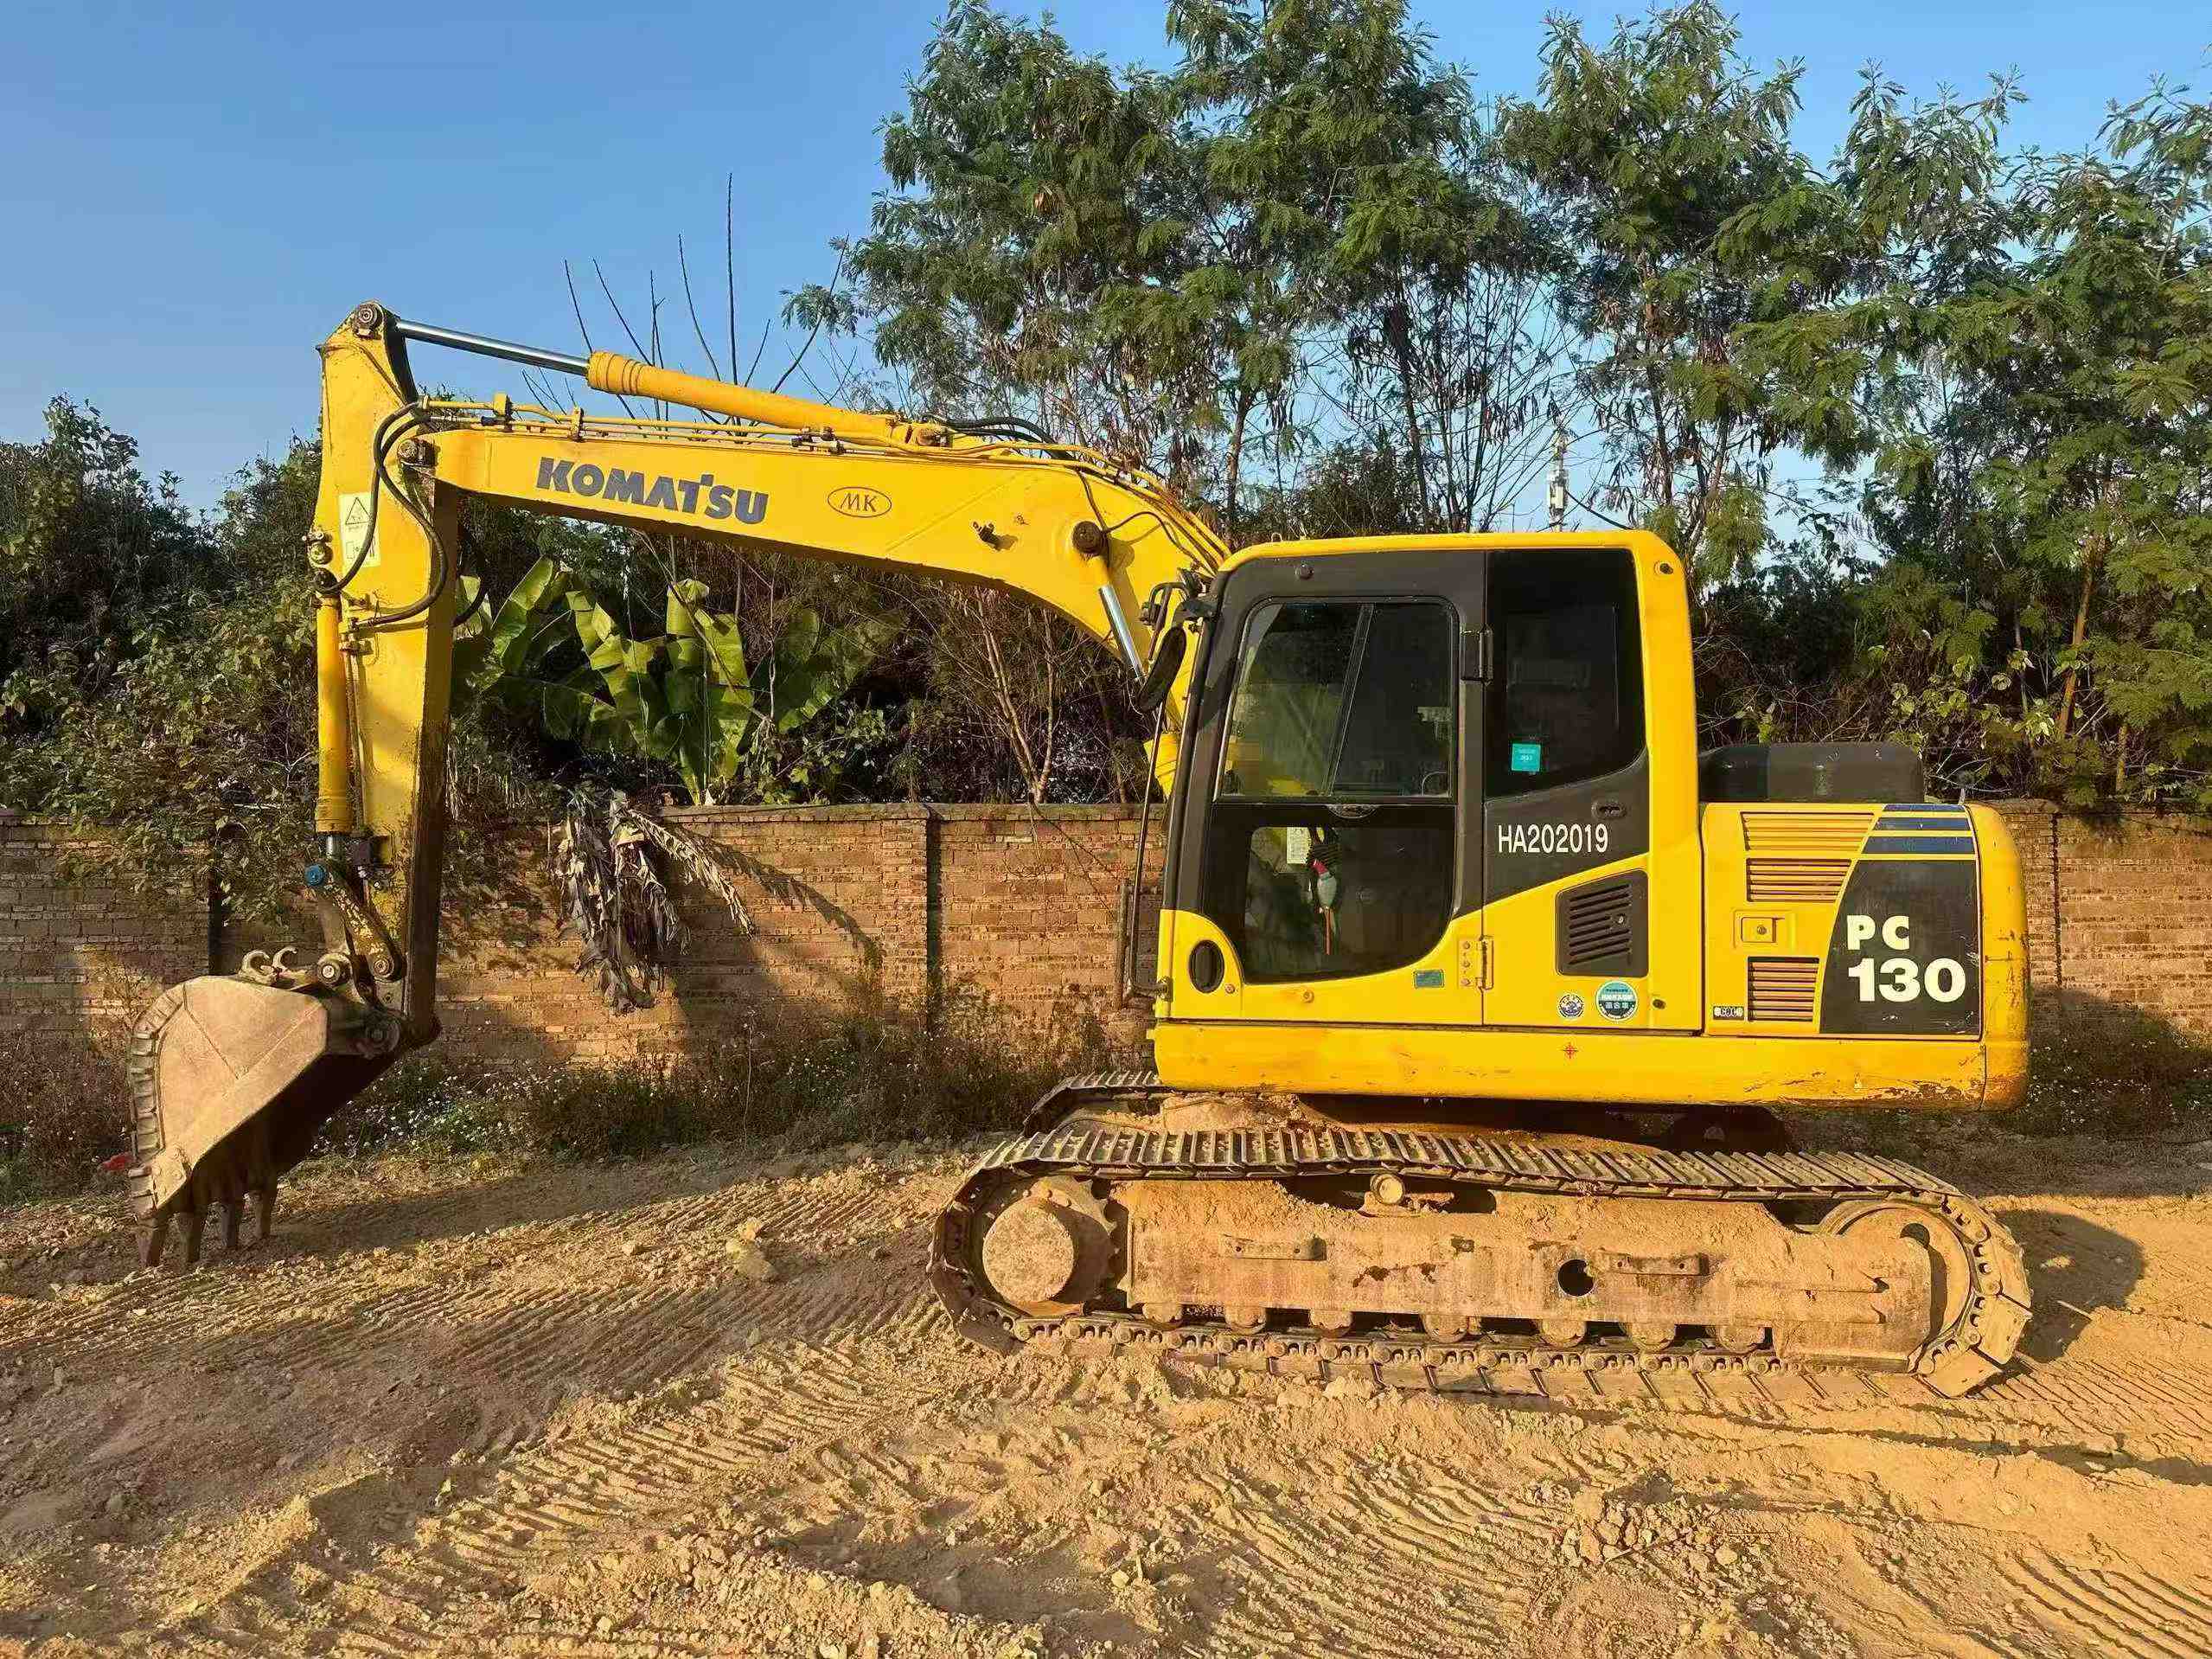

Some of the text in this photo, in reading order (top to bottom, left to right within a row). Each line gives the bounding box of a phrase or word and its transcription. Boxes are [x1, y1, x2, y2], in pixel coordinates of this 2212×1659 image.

[536, 457, 769, 524] KOMATSU
[840, 493, 876, 512] MK
[1498, 823, 1608, 853] HA202019
[1847, 914, 1909, 950] PC
[1848, 958, 1966, 1002] 130
